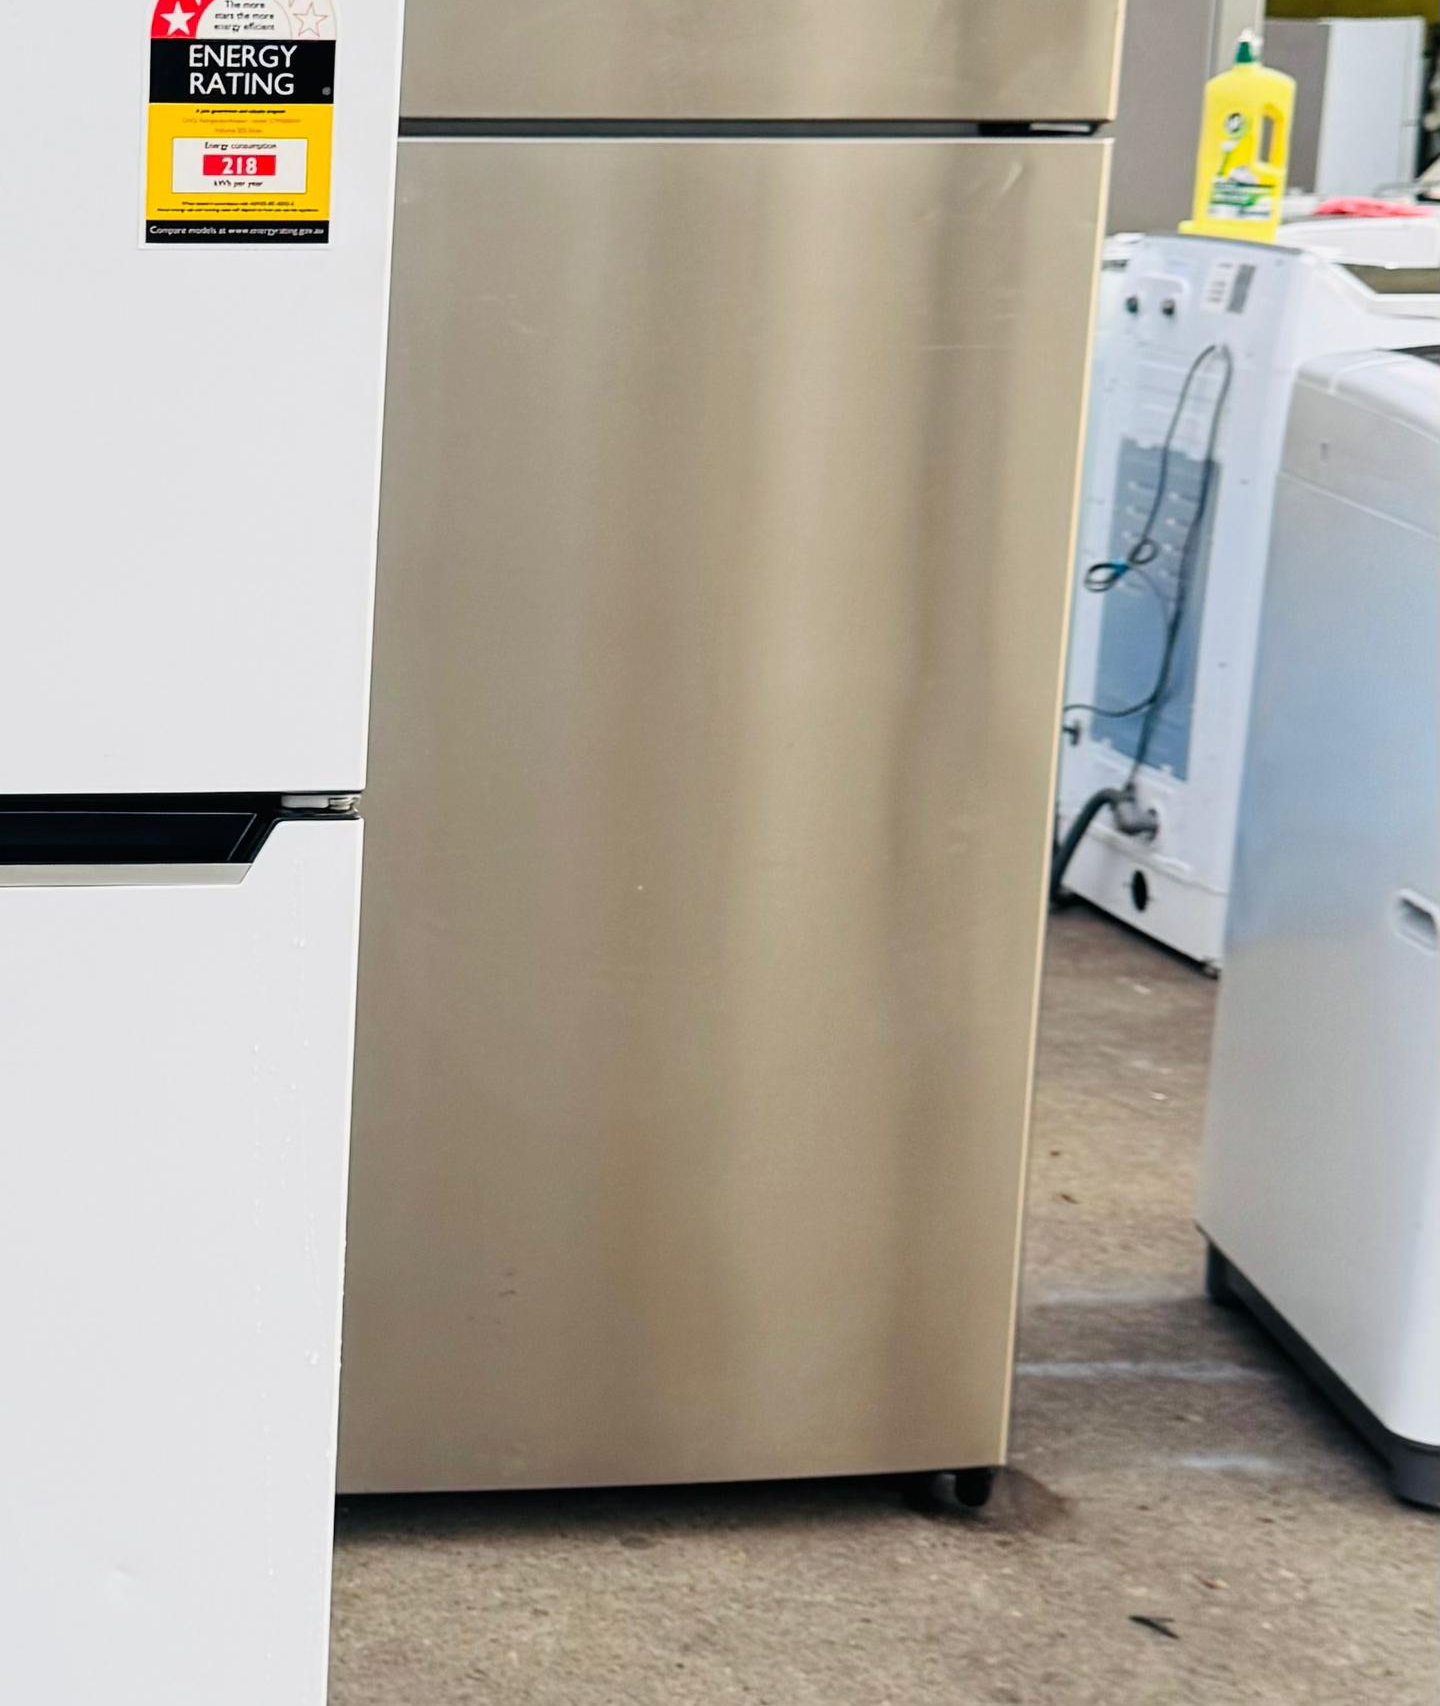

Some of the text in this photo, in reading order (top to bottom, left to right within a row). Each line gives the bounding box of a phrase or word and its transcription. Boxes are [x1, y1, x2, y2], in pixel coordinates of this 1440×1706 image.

[189, 44, 297, 69] ENERGY
[190, 72, 294, 95] RATING
[222, 156, 257, 174] 218
